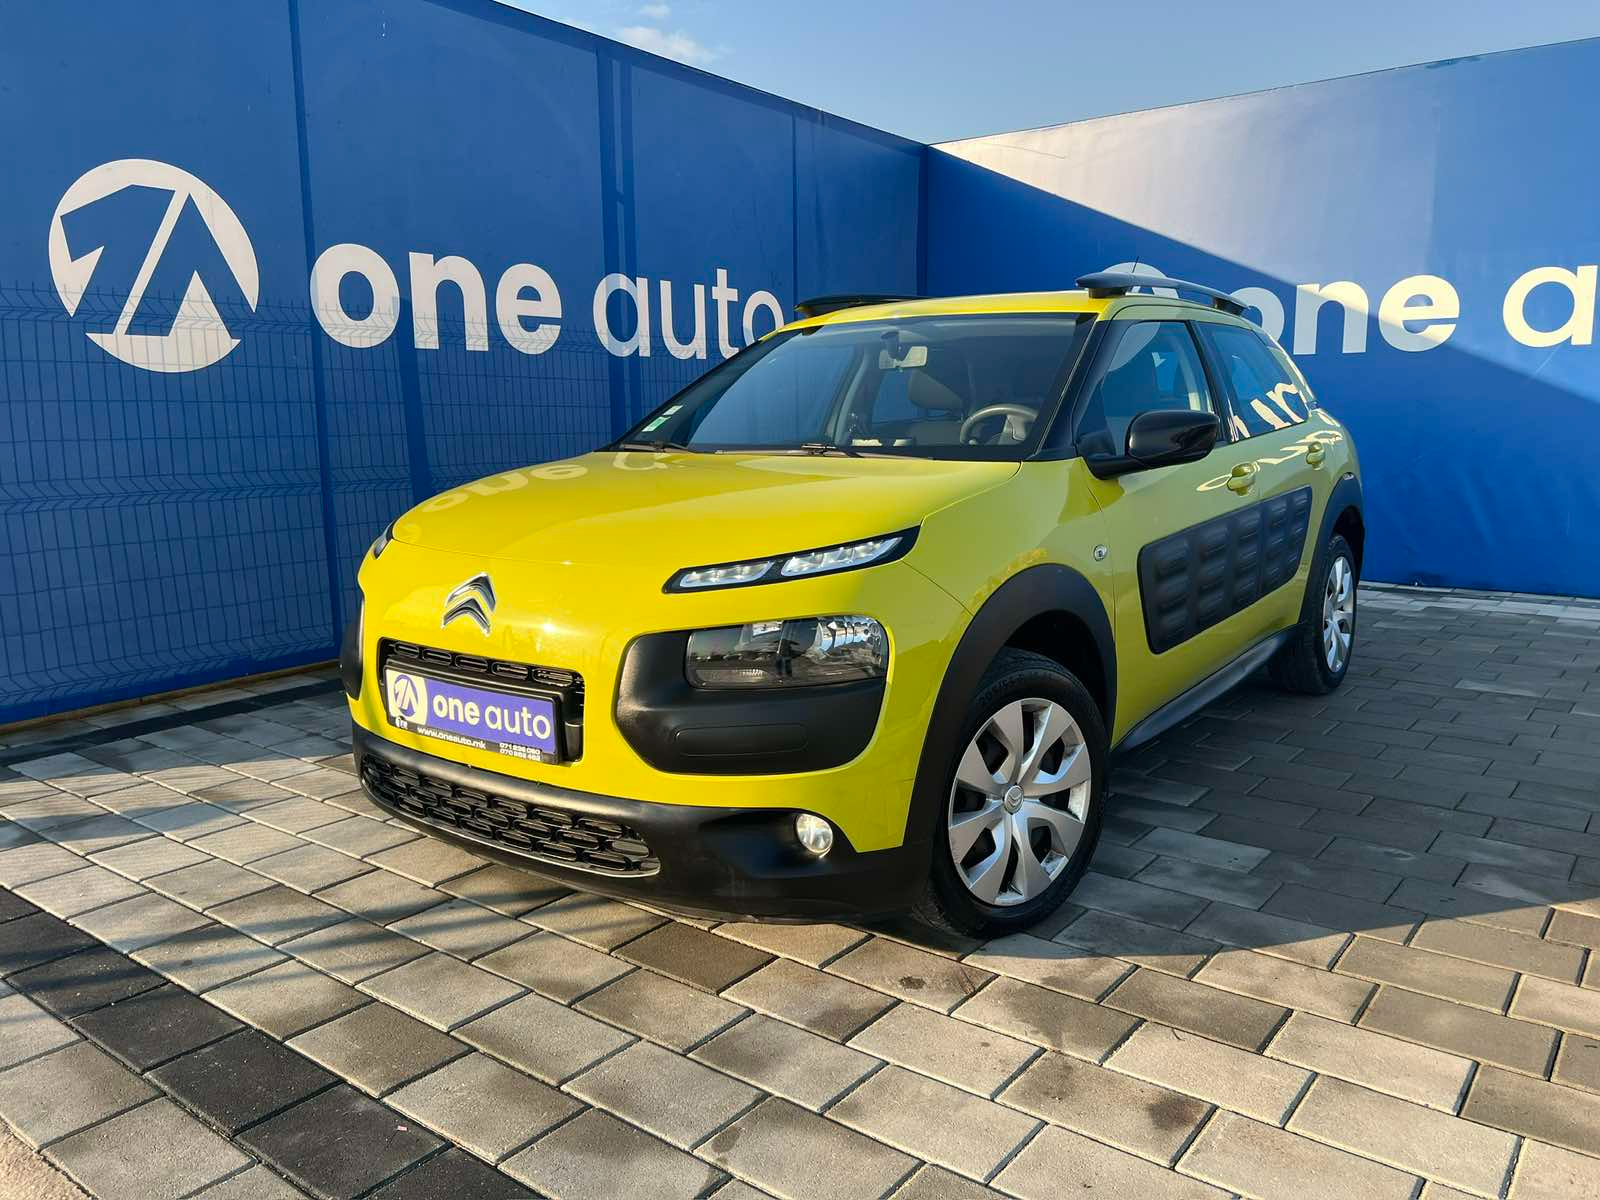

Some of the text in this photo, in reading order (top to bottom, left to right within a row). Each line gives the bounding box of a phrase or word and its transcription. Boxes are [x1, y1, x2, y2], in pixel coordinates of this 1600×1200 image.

[310, 243, 784, 360] one auto
[417, 727, 486, 750] www.oneauto.mk
[433, 695, 551, 739] one auto
